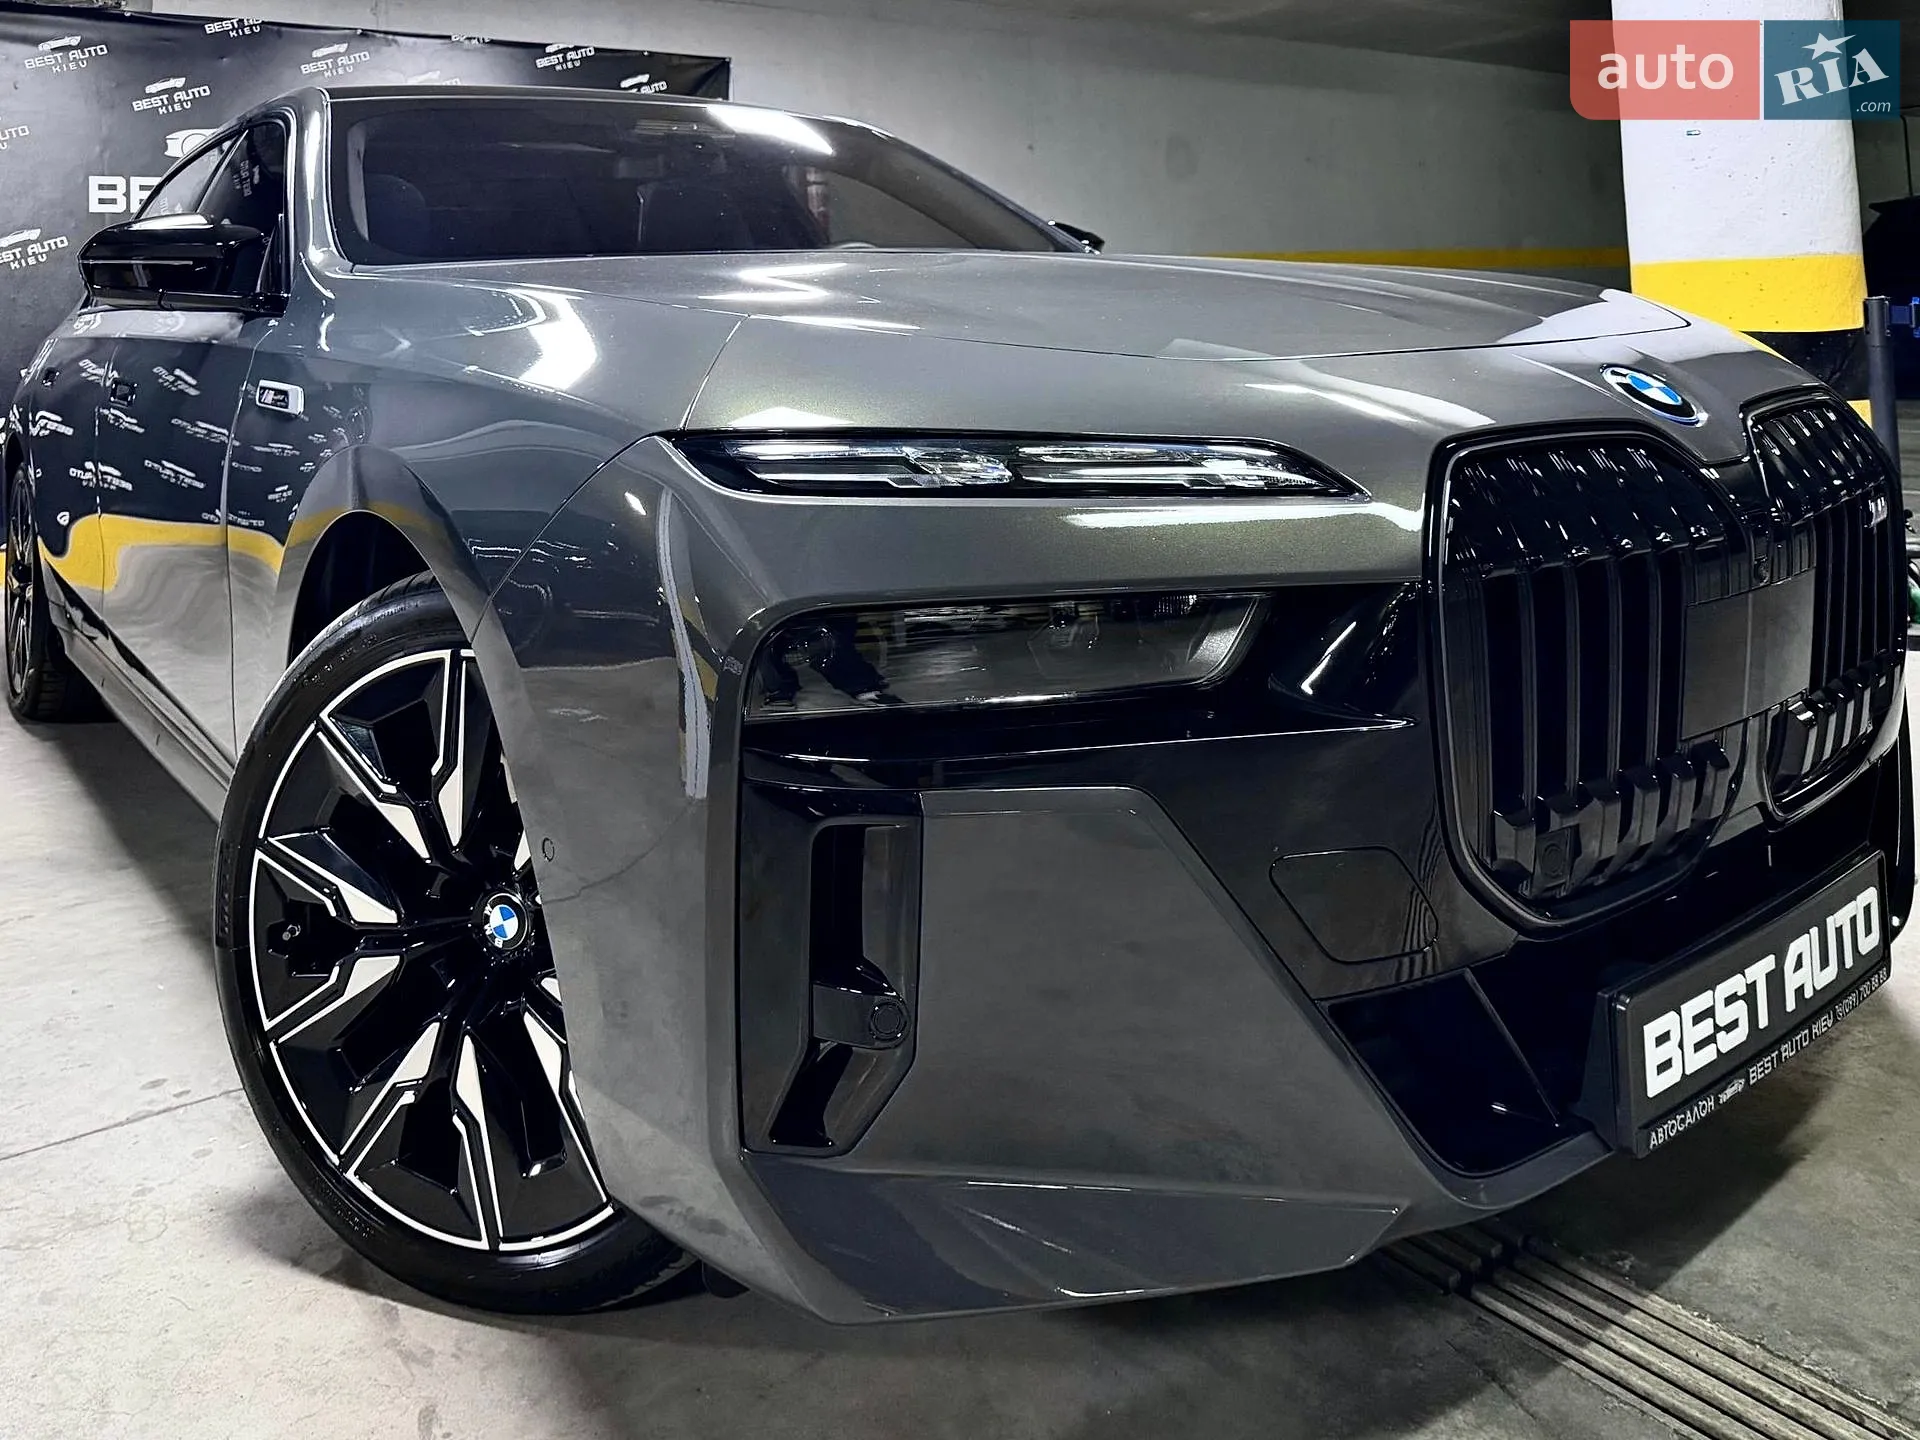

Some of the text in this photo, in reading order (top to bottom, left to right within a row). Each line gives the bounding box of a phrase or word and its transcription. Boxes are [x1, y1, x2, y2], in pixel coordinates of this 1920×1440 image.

[204, 18, 239, 34] BEST
[24, 44, 108, 69] BEST AUTO
[300, 51, 370, 74] BEST AUTO
[535, 46, 595, 68] BEST AUTO
[132, 85, 211, 112] BEST AUTO
[88, 176, 161, 213] BE
[27, 236, 69, 256] AUTO
[1643, 886, 1881, 1099] BEST AUTO
[1748, 1050, 1778, 1086] BEST
[1780, 1028, 1810, 1062] AUTO
[1649, 1094, 1716, 1150] АВТОСАЛОН
